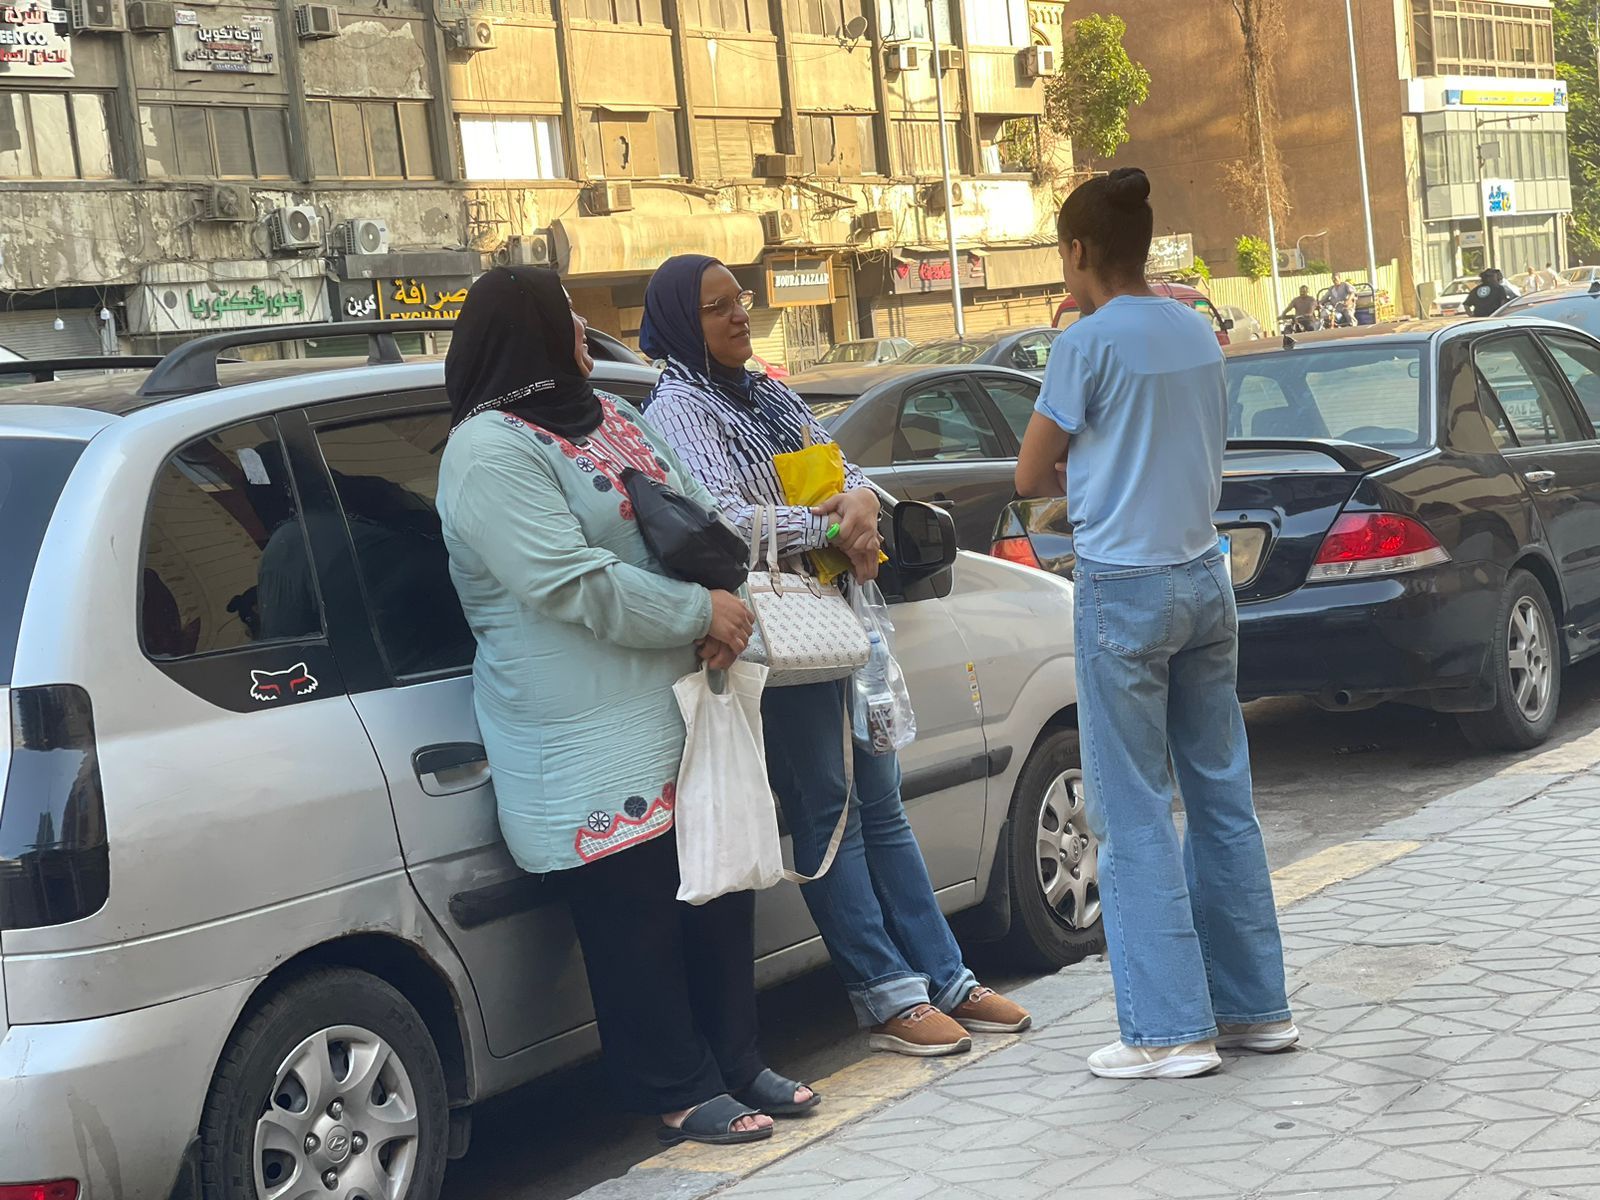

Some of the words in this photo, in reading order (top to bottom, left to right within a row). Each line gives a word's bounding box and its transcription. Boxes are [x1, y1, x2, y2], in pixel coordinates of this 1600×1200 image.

[198, 24, 233, 42] تكوين
[234, 25, 263, 42] شركة
[263, 288, 305, 318] زهور
[393, 278, 468, 310] صرافة
